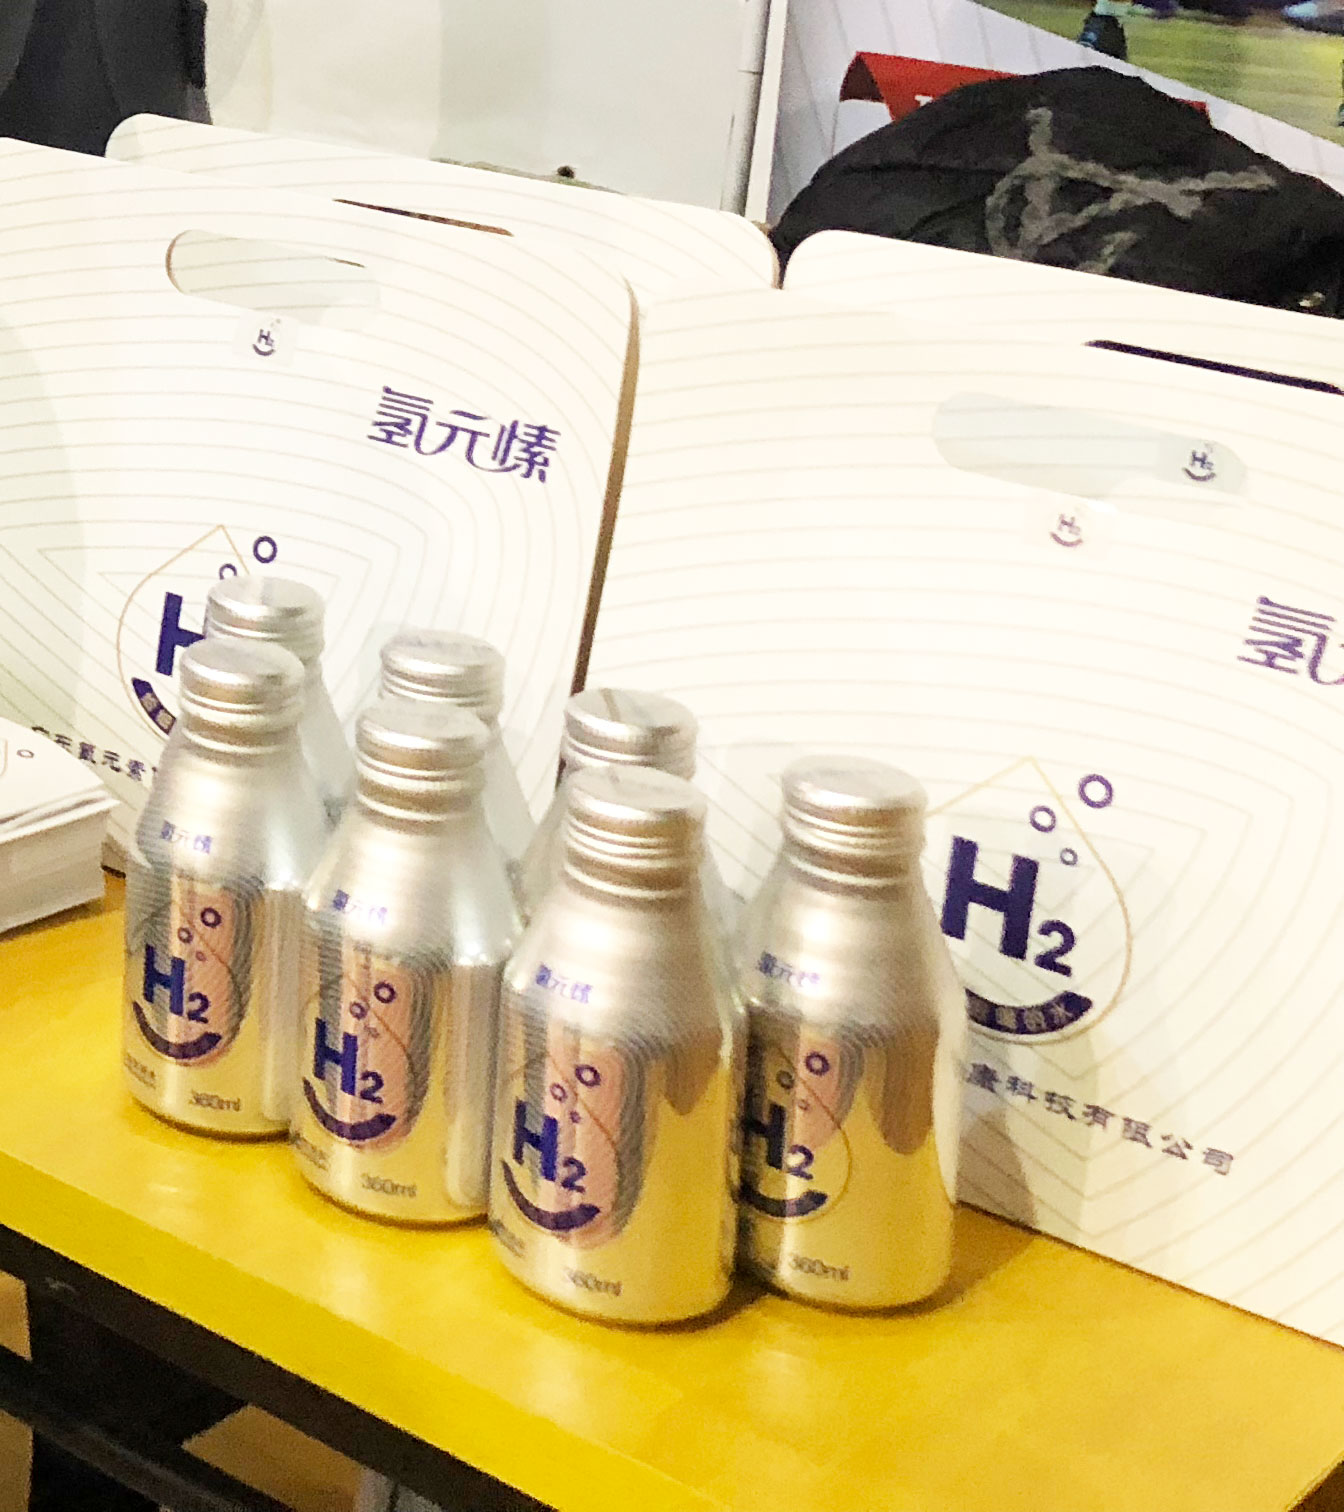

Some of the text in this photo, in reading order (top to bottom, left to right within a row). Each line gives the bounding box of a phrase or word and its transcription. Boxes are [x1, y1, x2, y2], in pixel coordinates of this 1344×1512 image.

[939, 834, 1078, 978] H2
[142, 942, 211, 1024] H2
[313, 1016, 385, 1105] H2
[512, 1095, 587, 1194] H2
[964, 1062, 1236, 1177] 康科技有限公司
